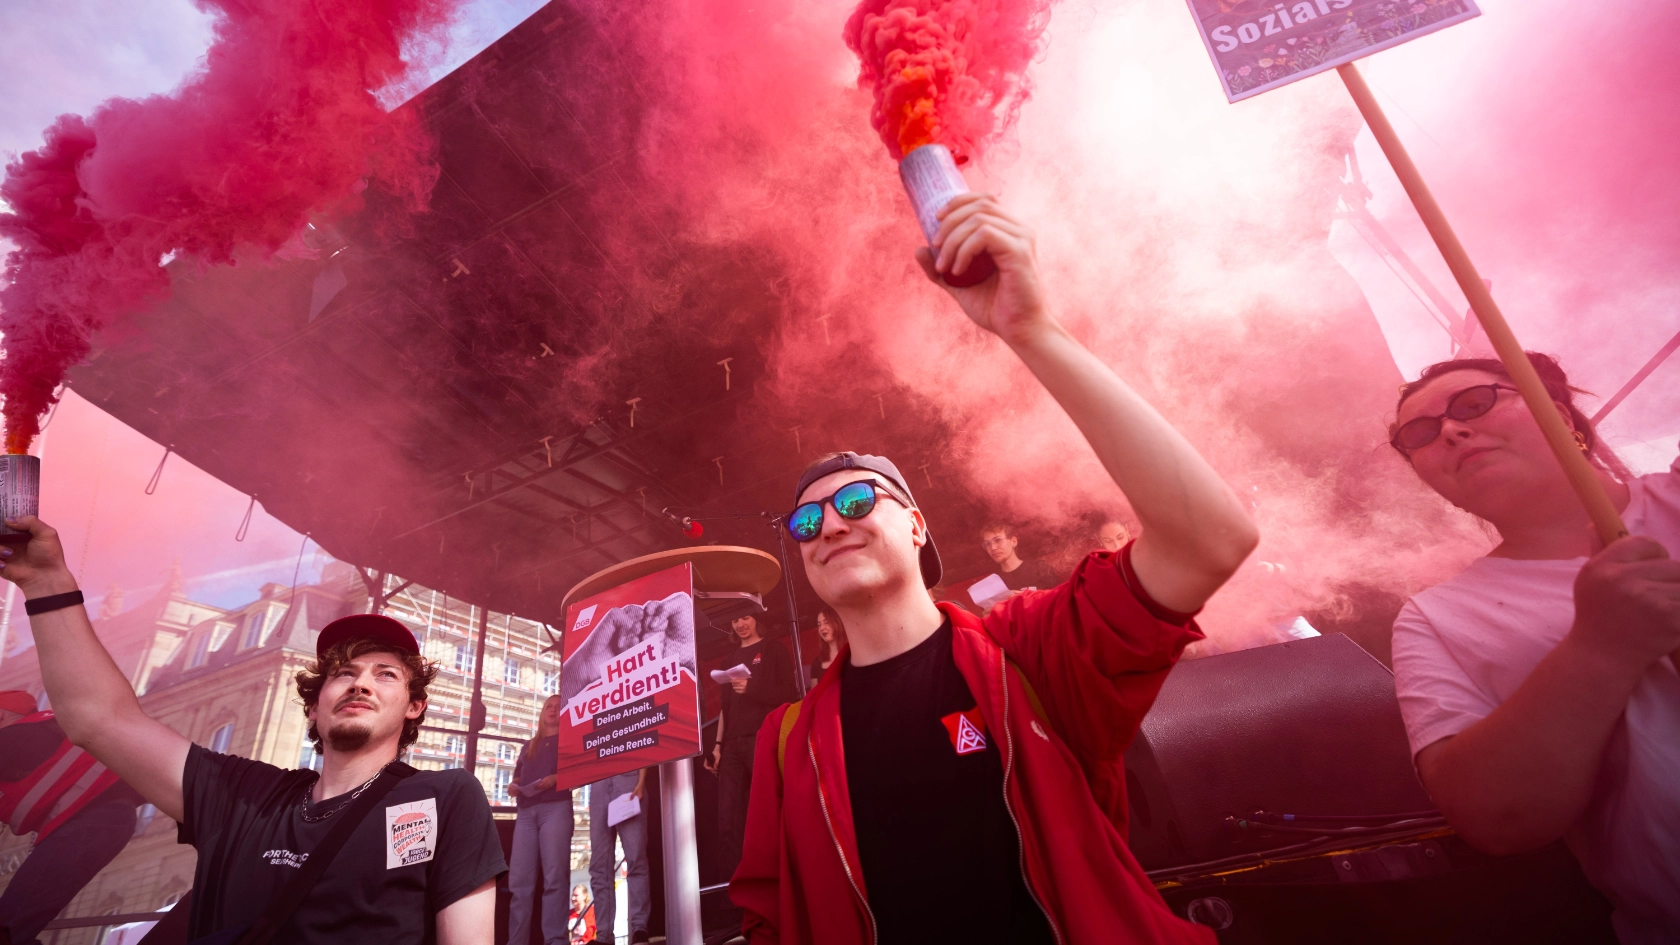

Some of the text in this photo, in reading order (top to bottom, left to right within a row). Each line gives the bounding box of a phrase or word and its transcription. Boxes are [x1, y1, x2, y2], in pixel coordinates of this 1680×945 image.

[575, 618, 590, 629] DGB
[606, 644, 656, 683] Hart
[574, 661, 678, 719] verdient!
[596, 701, 652, 727] Deine Arbeit.
[586, 711, 666, 749] Deine Gesundheit.
[599, 735, 655, 758] Deine Rente.
[392, 819, 431, 835] MENTAL
[393, 825, 425, 842] HEALTH
[395, 835, 423, 855] WEALTH
[404, 851, 429, 864] JUGEND
